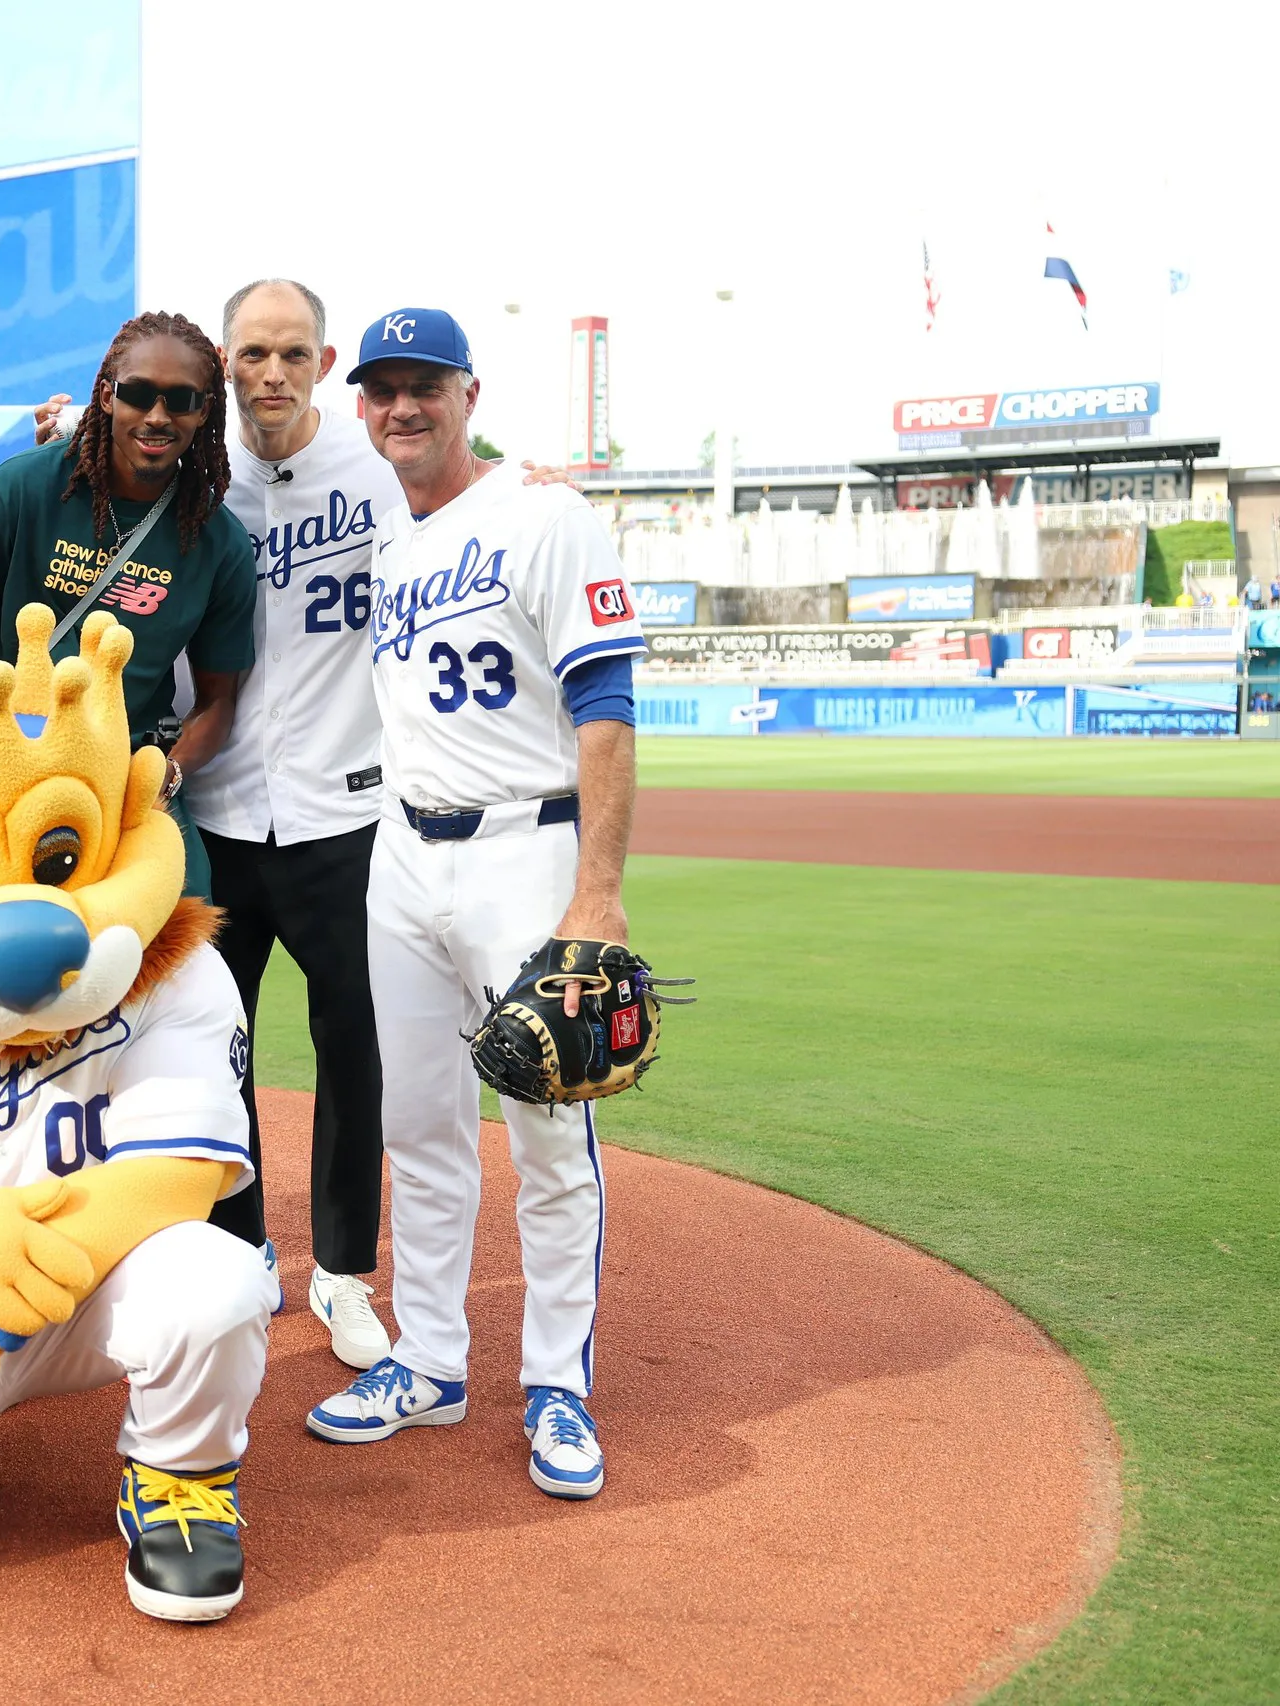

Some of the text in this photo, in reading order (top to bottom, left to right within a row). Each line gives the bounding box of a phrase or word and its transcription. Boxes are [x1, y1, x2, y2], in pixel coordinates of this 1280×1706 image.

[381, 314, 416, 343] KC
[901, 386, 1148, 428] PRICE CHOPPER
[1039, 473, 1184, 503] HOPPER
[249, 489, 376, 589] oyals
[55, 539, 172, 584] new bance
[44, 574, 93, 598] shoe
[305, 572, 371, 633] 26
[370, 537, 508, 661] Royals
[594, 585, 627, 618] QT
[652, 633, 894, 652] GREAT VIEWS FRESH FOOD
[1028, 632, 1062, 657] QT
[429, 641, 517, 713] 33
[814, 698, 876, 727] KANSAS
[230, 1031, 247, 1073] KC
